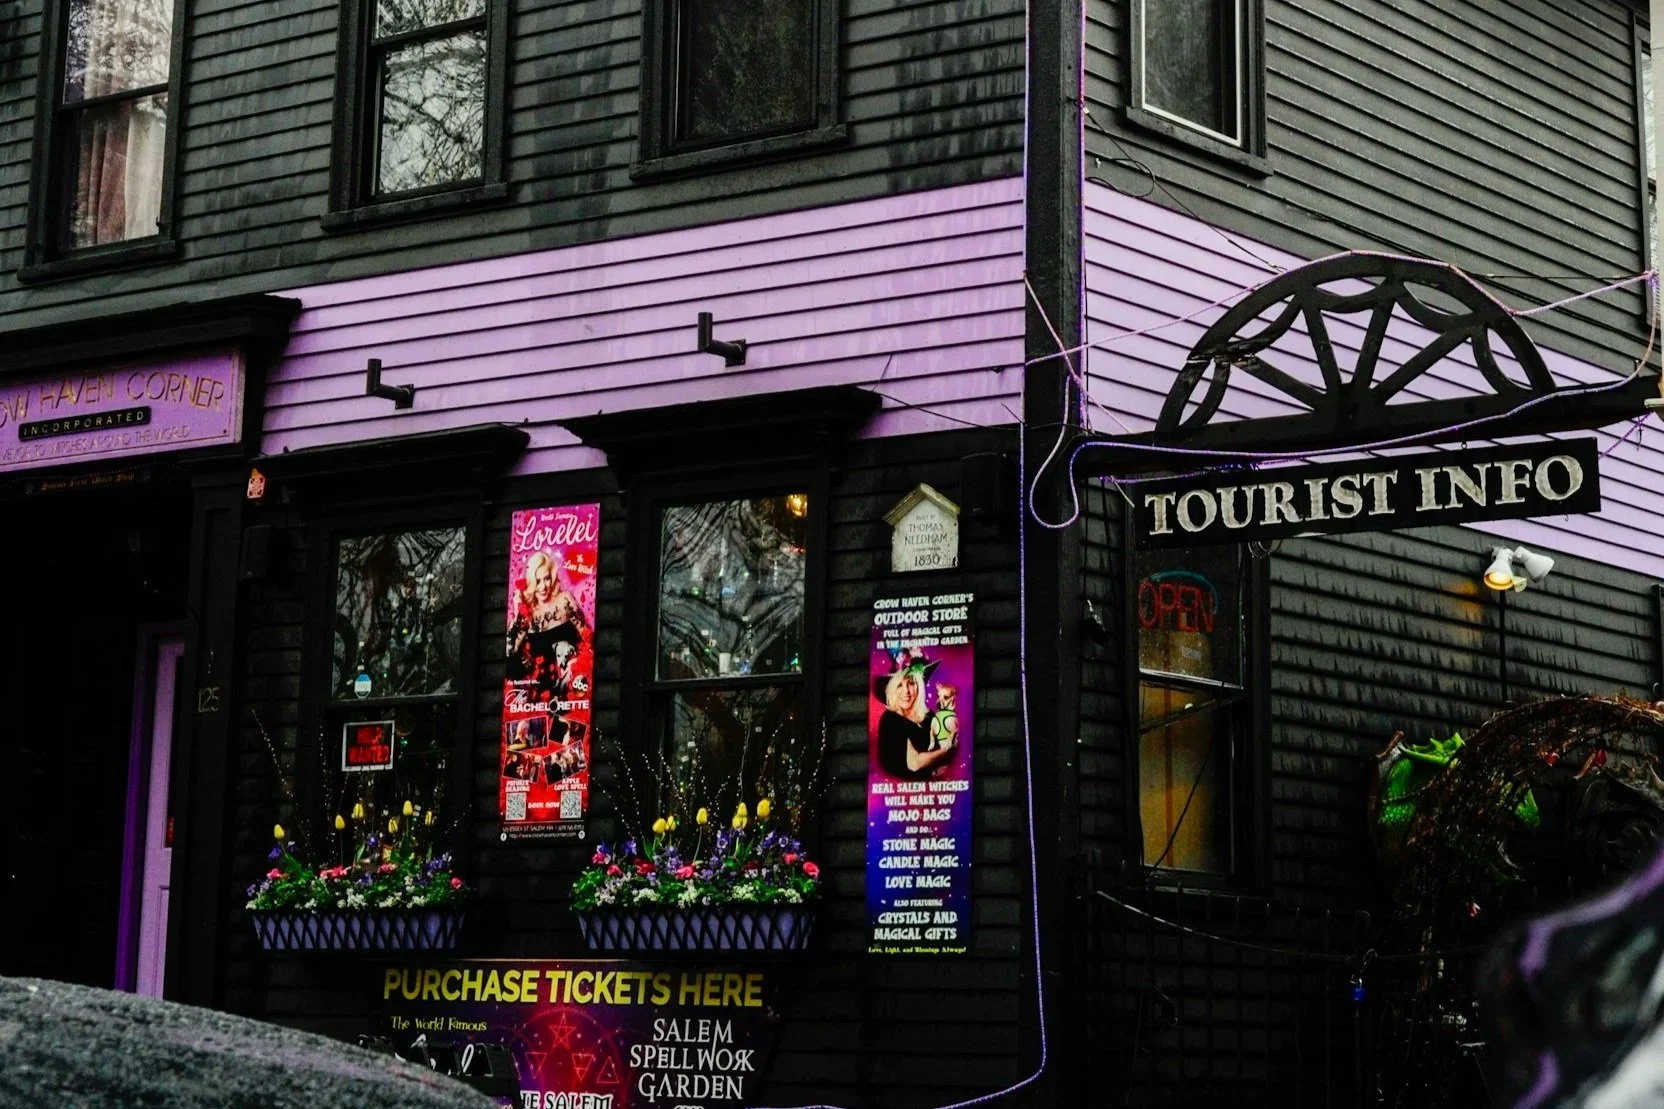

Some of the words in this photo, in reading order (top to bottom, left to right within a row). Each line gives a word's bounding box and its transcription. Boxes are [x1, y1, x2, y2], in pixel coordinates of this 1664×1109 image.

[40, 373, 114, 412] HAVEN
[127, 371, 224, 409] CORNER
[23, 411, 144, 435] INCORPORATED
[34, 444, 46, 456] TO
[135, 430, 150, 442] THE
[153, 425, 190, 441] WORLD
[1145, 469, 1399, 536] TOURIST
[1415, 454, 1583, 512] INFO
[514, 514, 596, 552] Lorelei
[908, 523, 943, 532] THOMAS
[904, 533, 947, 545] NEEDHAM
[915, 553, 940, 566] 1830
[874, 599, 899, 609] CROW
[901, 596, 930, 607] HAVEN
[932, 593, 974, 605] CORNER'S
[1138, 579, 1214, 633] OPEN
[874, 610, 930, 625] OUTDOOR
[932, 606, 968, 621] STORE
[883, 629, 899, 638] FULL
[901, 628, 910, 637] OF
[911, 627, 941, 636] MAGICAL
[942, 625, 962, 634] GIFTS
[876, 641, 885, 649] IN
[901, 637, 939, 648] ENCHANTED
[941, 636, 968, 645] GARDEN
[572, 680, 588, 691] abc
[504, 689, 528, 707] The
[510, 698, 590, 713] BACHELORETTE
[872, 783, 894, 794] REAL
[897, 782, 926, 793] SALEM
[929, 781, 969, 791] WITCHES
[884, 796, 907, 806] WILL
[909, 794, 935, 805] MAKE
[937, 794, 956, 805] YOU
[888, 810, 920, 822] MOJO
[923, 809, 951, 821] BAGS
[905, 826, 918, 834] AND
[882, 839, 917, 851] STONE
[920, 838, 956, 850] MAGIC
[878, 856, 920, 869] CANDLE
[923, 856, 959, 868] MAGIC
[885, 876, 913, 889] LOVE
[916, 875, 951, 888] MAGIC
[893, 899, 909, 907] ALSO
[910, 899, 943, 907] FEATURING
[878, 911, 930, 924] CRYSTALS
[933, 911, 958, 924] AND
[873, 928, 921, 940] MAGICAL
[924, 927, 957, 940] GIFTS
[383, 968, 540, 1003] PURCHASE
[545, 970, 671, 1006] TICKETS
[679, 972, 764, 1007] HERE
[391, 1016, 410, 1030] The
[415, 1016, 444, 1031] World
[448, 1017, 487, 1031] Famous
[653, 1018, 733, 1044] SALEM
[638, 1072, 744, 1102] GARDEN
